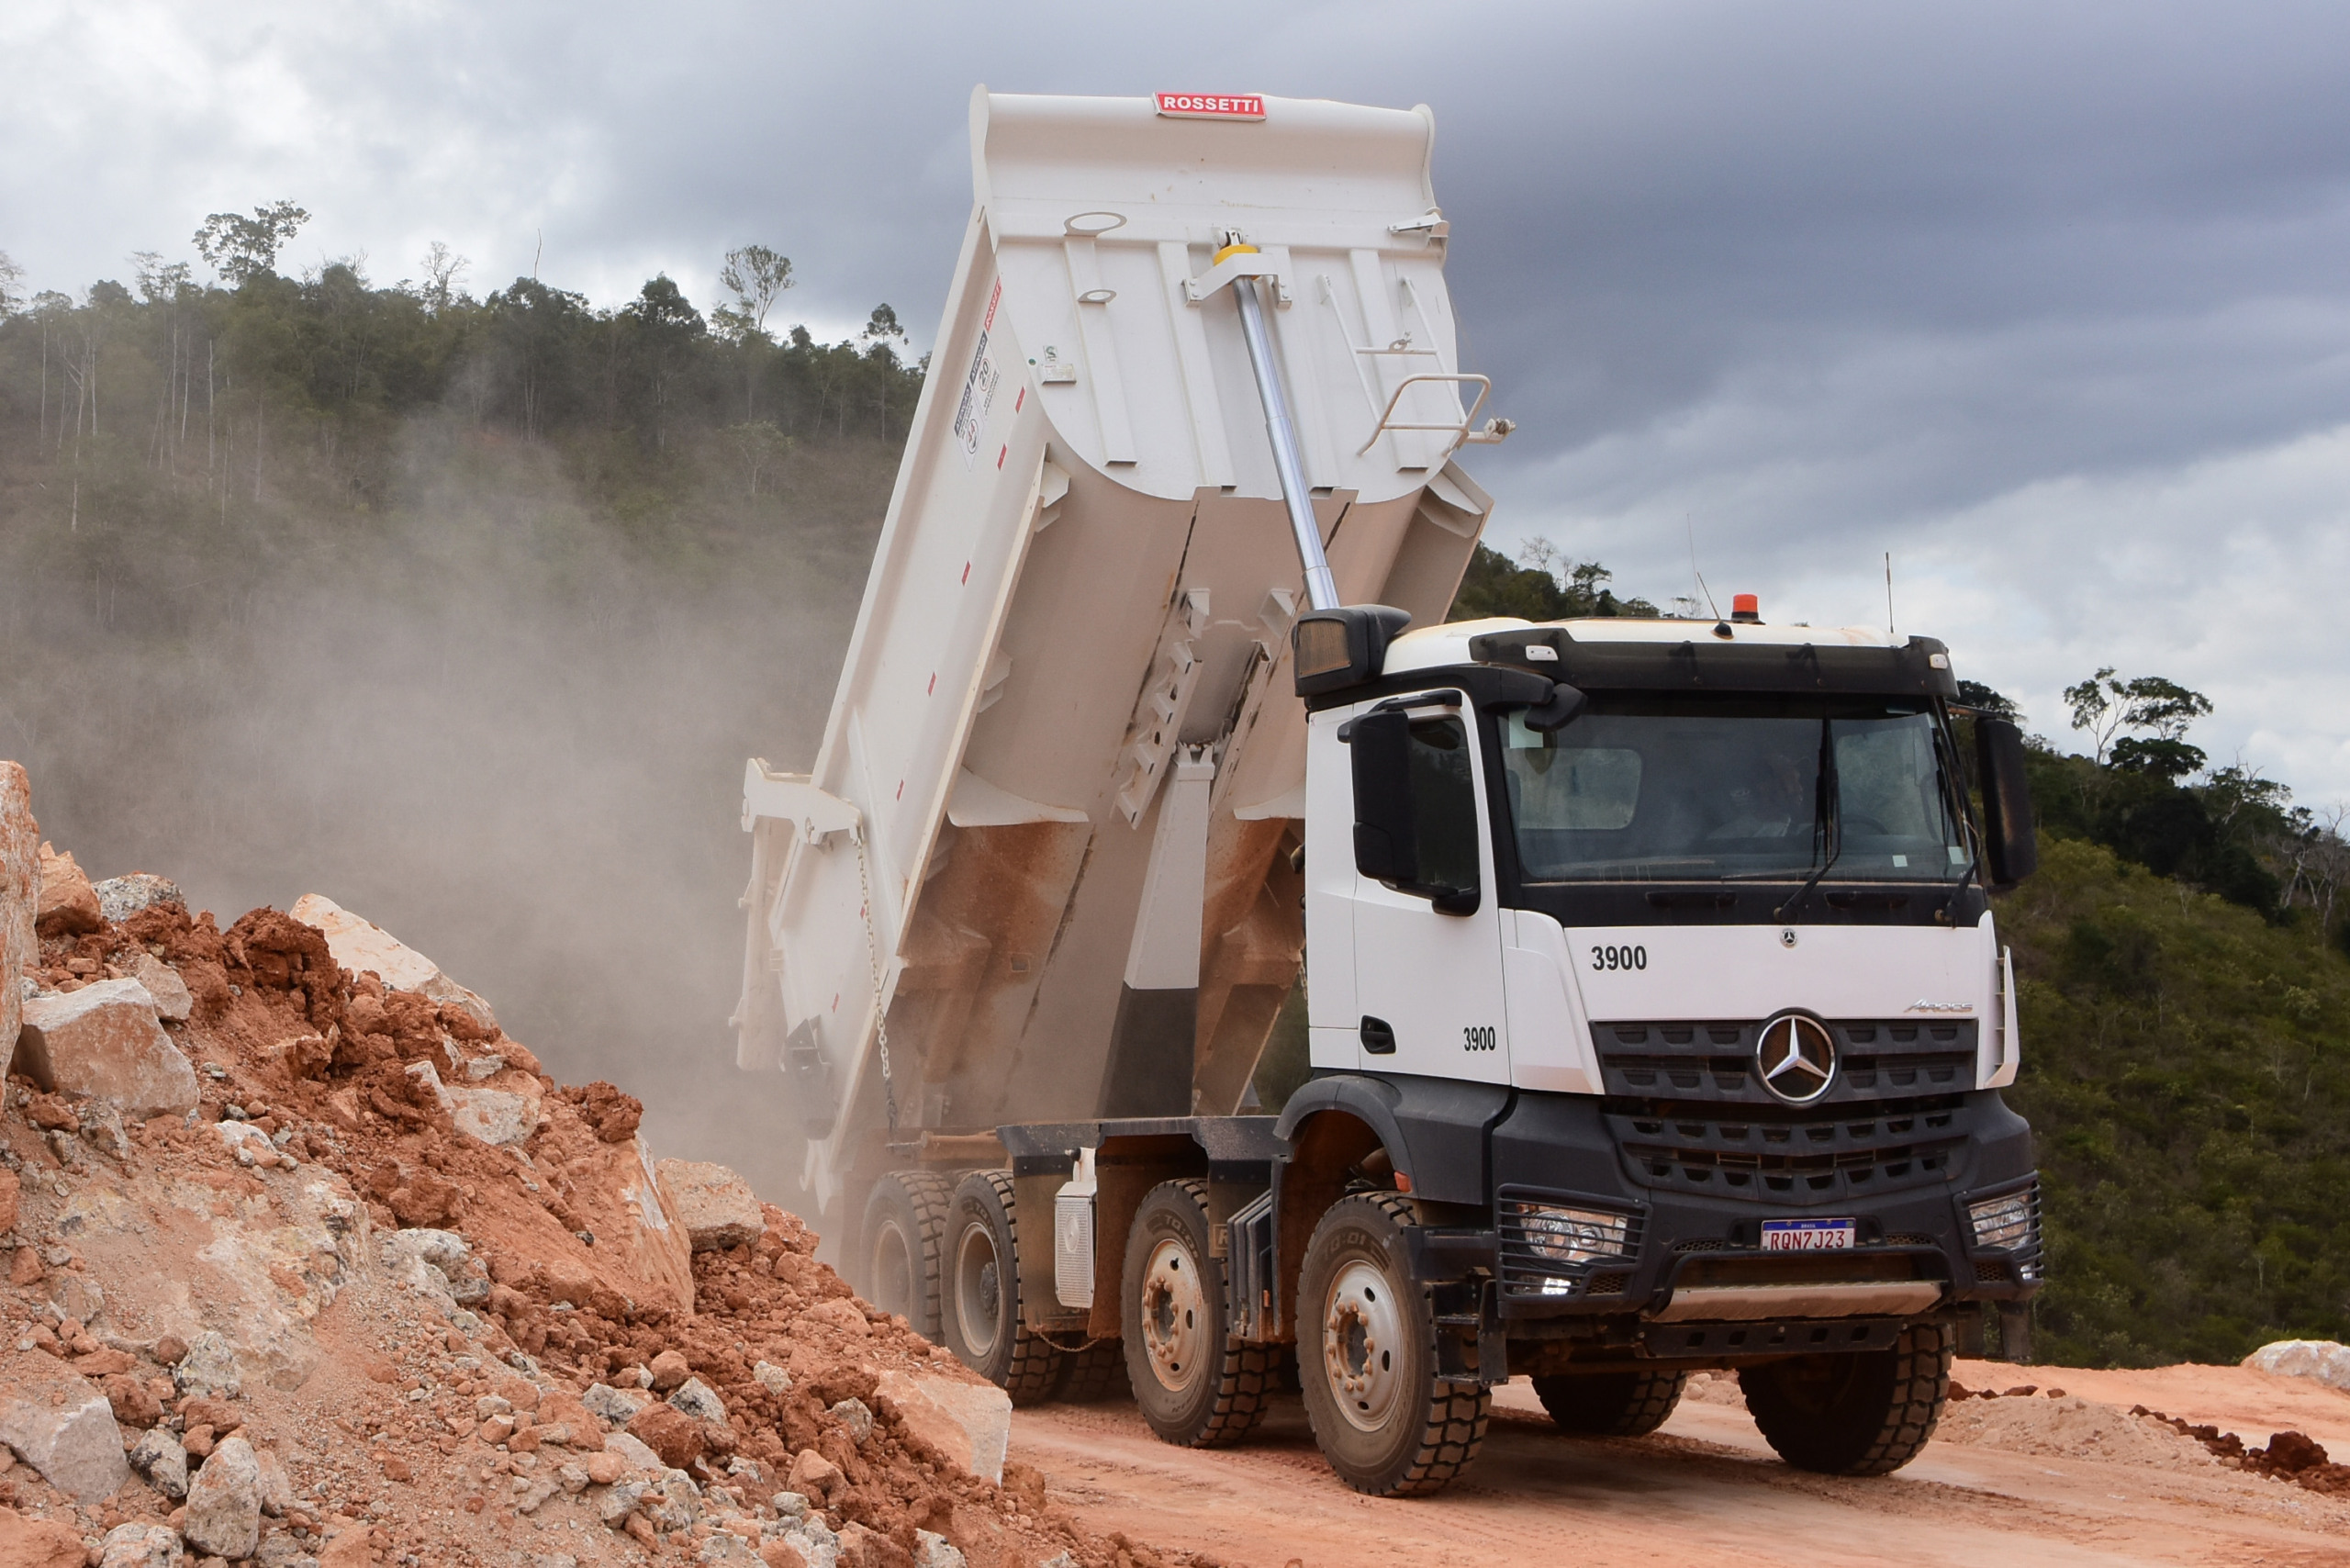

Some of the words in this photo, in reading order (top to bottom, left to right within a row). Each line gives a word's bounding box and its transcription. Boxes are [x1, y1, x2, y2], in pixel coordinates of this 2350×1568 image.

[1164, 96, 1259, 112] ROSSETTI
[1591, 946, 1647, 970] 3900
[1463, 1026, 1495, 1051] 3900
[1770, 1230, 1845, 1250] RQN7J23
